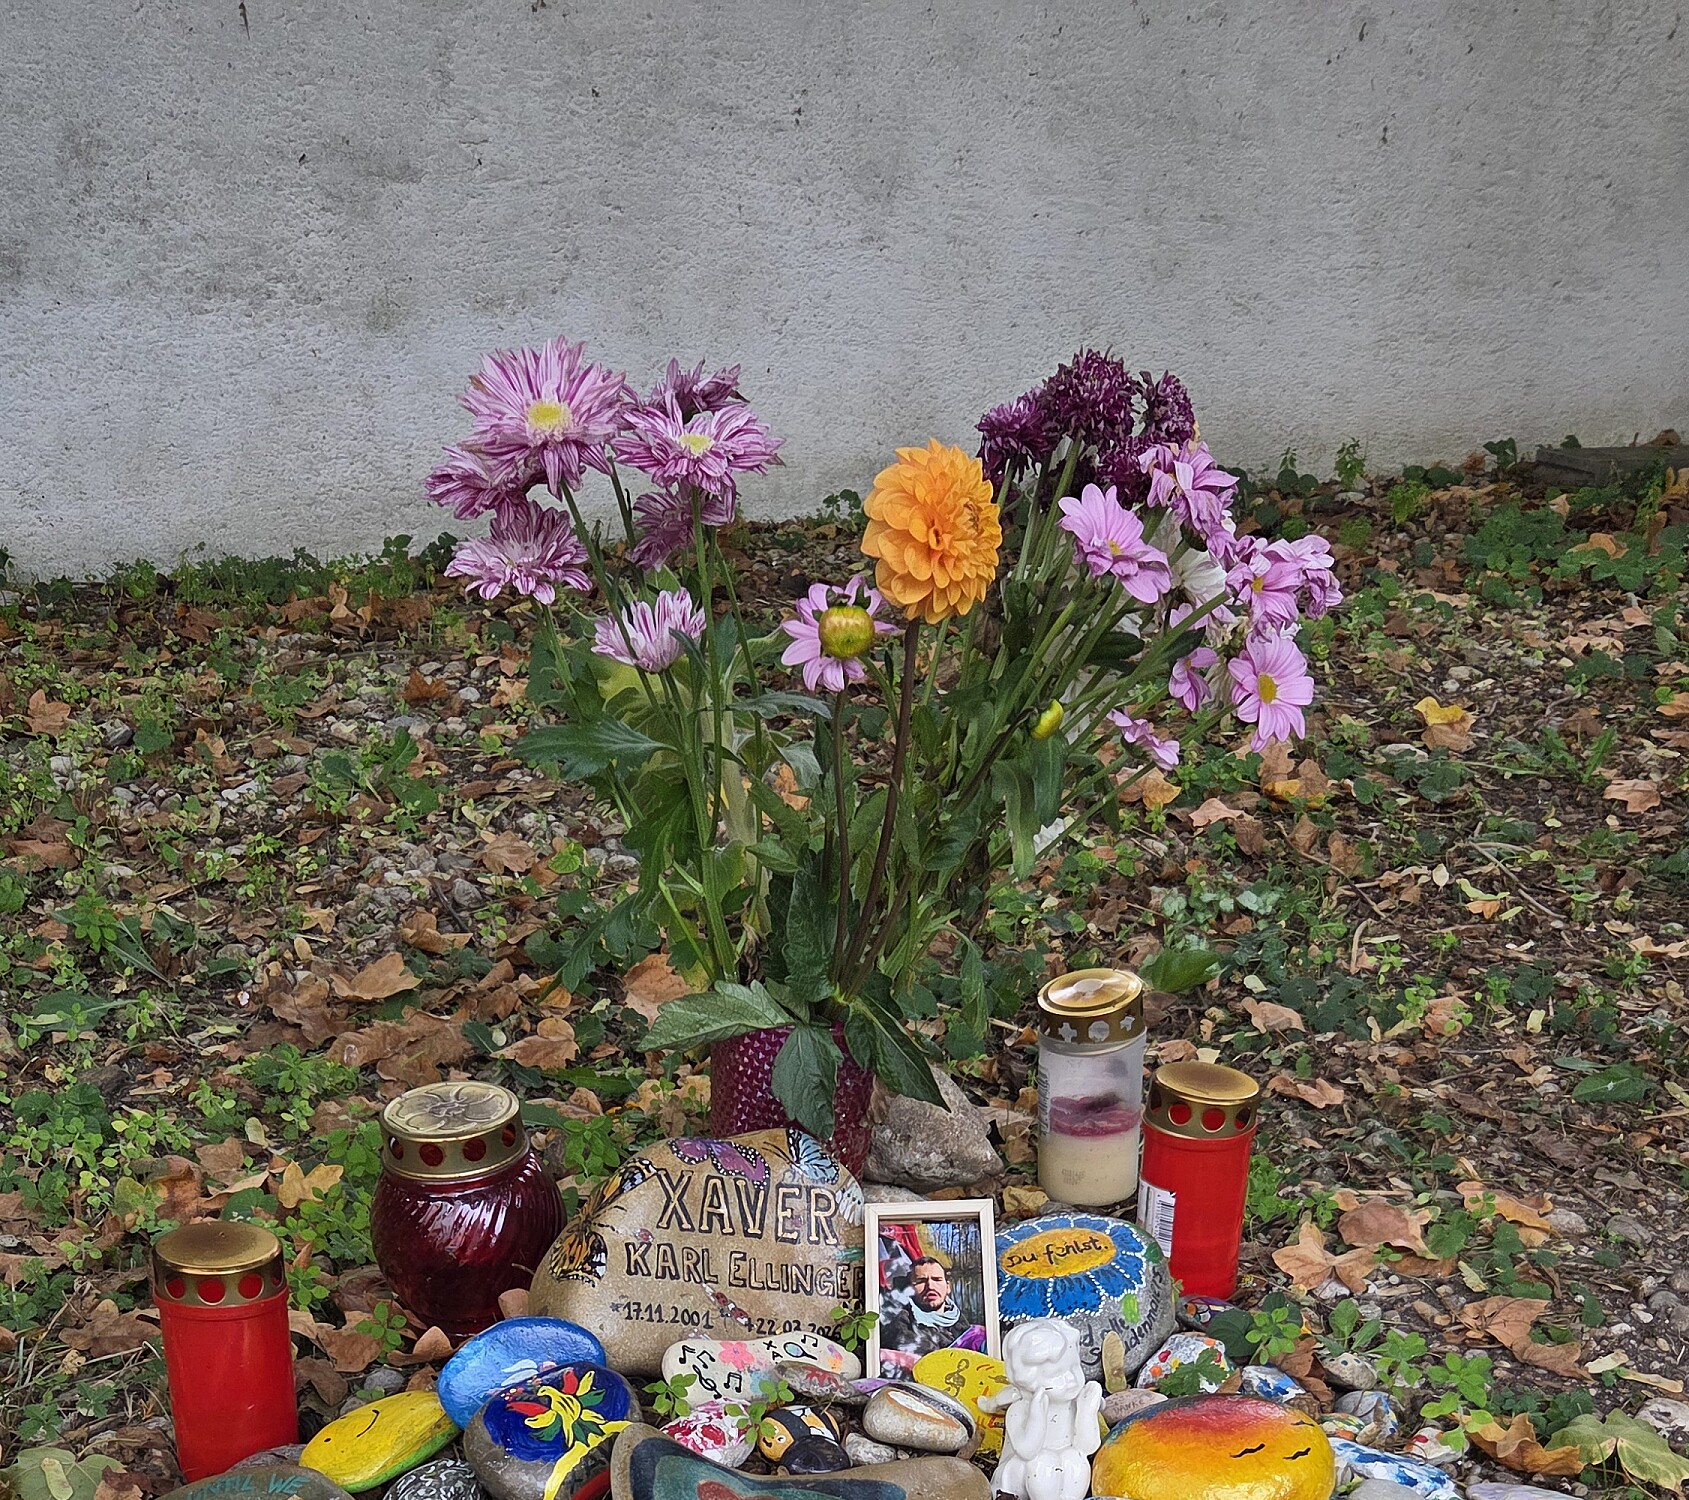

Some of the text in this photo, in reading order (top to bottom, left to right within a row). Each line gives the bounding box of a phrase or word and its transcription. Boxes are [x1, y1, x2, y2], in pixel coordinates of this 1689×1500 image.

[656, 1168, 838, 1246] XAVER
[625, 1242, 718, 1284] KARL
[1006, 1252, 1038, 1268] Du
[266, 1473, 310, 1496] WE
